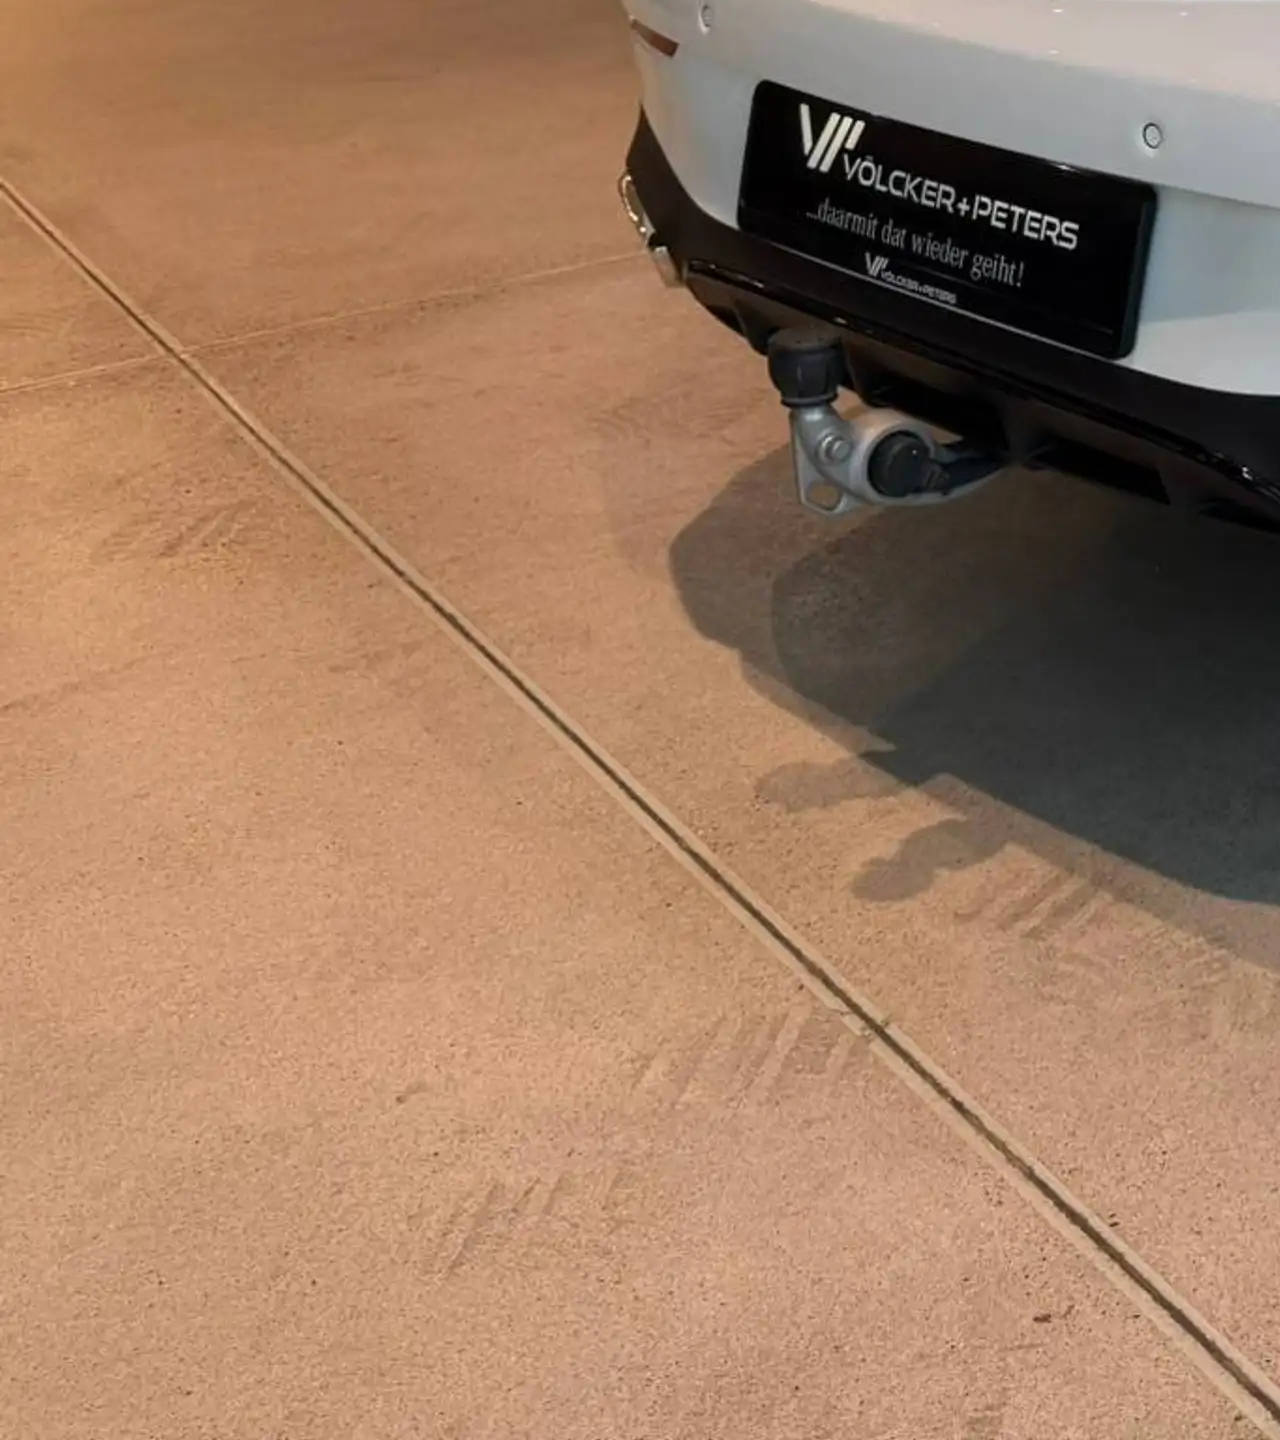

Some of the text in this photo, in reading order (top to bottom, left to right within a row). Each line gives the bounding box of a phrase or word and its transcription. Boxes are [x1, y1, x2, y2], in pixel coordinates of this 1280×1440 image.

[843, 154, 1080, 251] VÖLCKER+PETERS
[881, 218, 907, 249] dat
[911, 232, 969, 269] wieder
[970, 253, 1025, 289] geiht!
